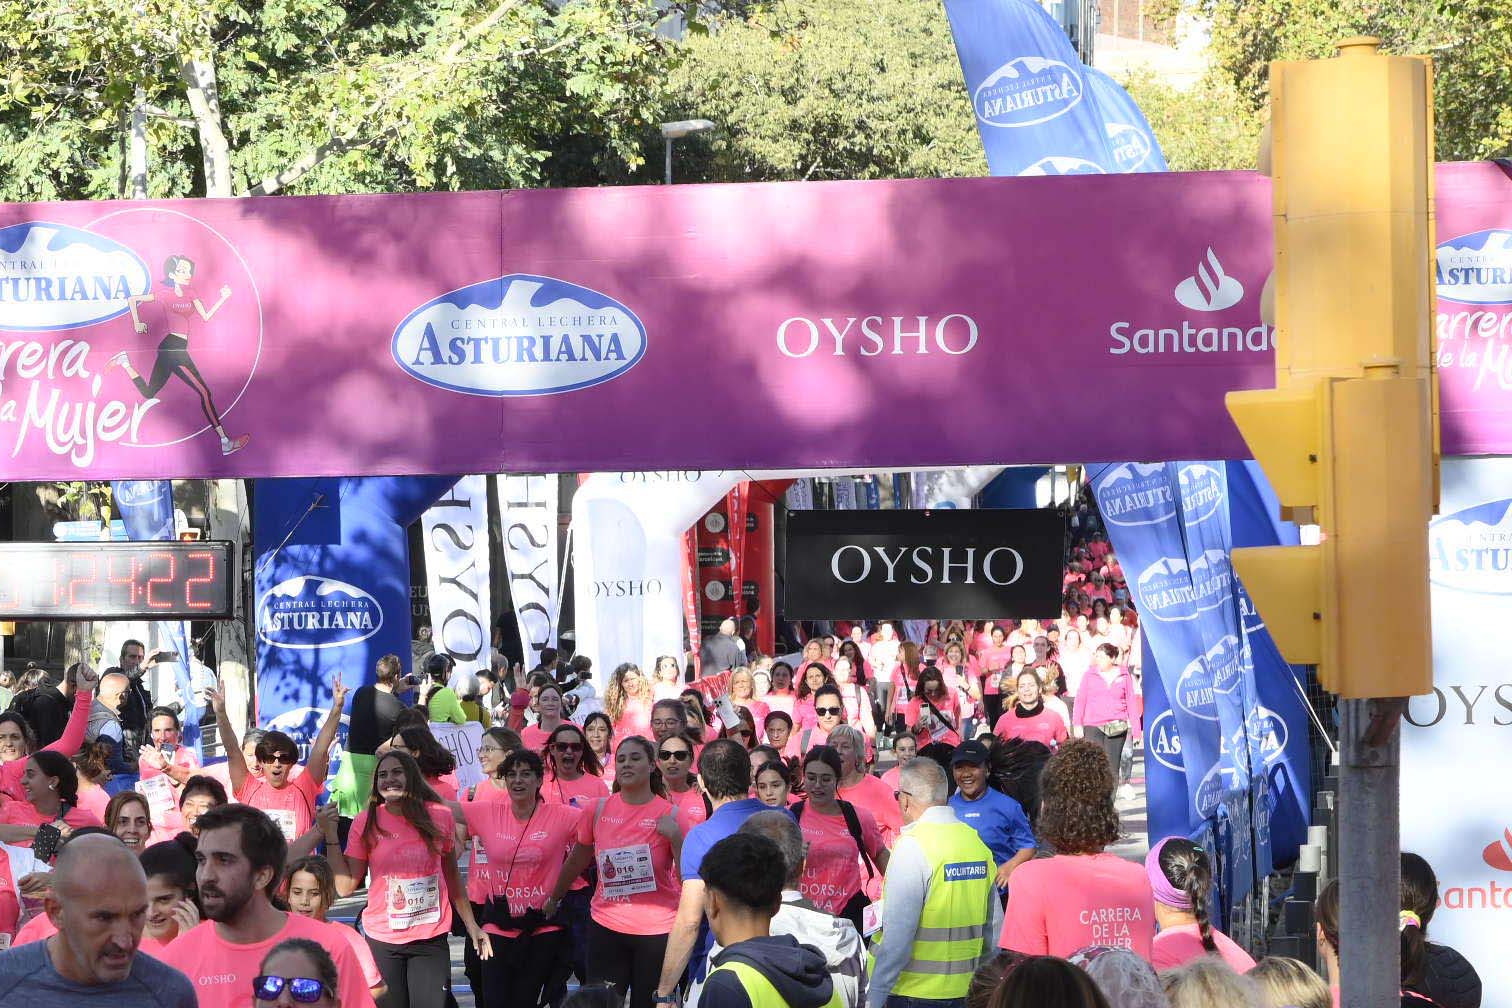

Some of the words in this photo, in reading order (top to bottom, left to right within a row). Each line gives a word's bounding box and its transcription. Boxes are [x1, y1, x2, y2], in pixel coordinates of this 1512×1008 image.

[450, 316, 529, 330] CENTRAL
[538, 314, 619, 328] LECHERA
[412, 320, 628, 366] ASTURIANA
[776, 314, 979, 358] OYSHO
[12, 371, 163, 467] Mujer
[831, 545, 1024, 586] OYSHO
[274, 600, 316, 610] CENTRAL
[321, 600, 369, 609] LECHERA
[262, 606, 375, 632] ASTURIANA
[616, 865, 635, 875] 016
[945, 866, 986, 877] VOLUNTARIS
[800, 884, 848, 897] DORSAL
[407, 896, 425, 907] 016
[1080, 907, 1142, 925] CARRERA
[1092, 924, 1110, 937] DE
[1114, 923, 1130, 936] LA
